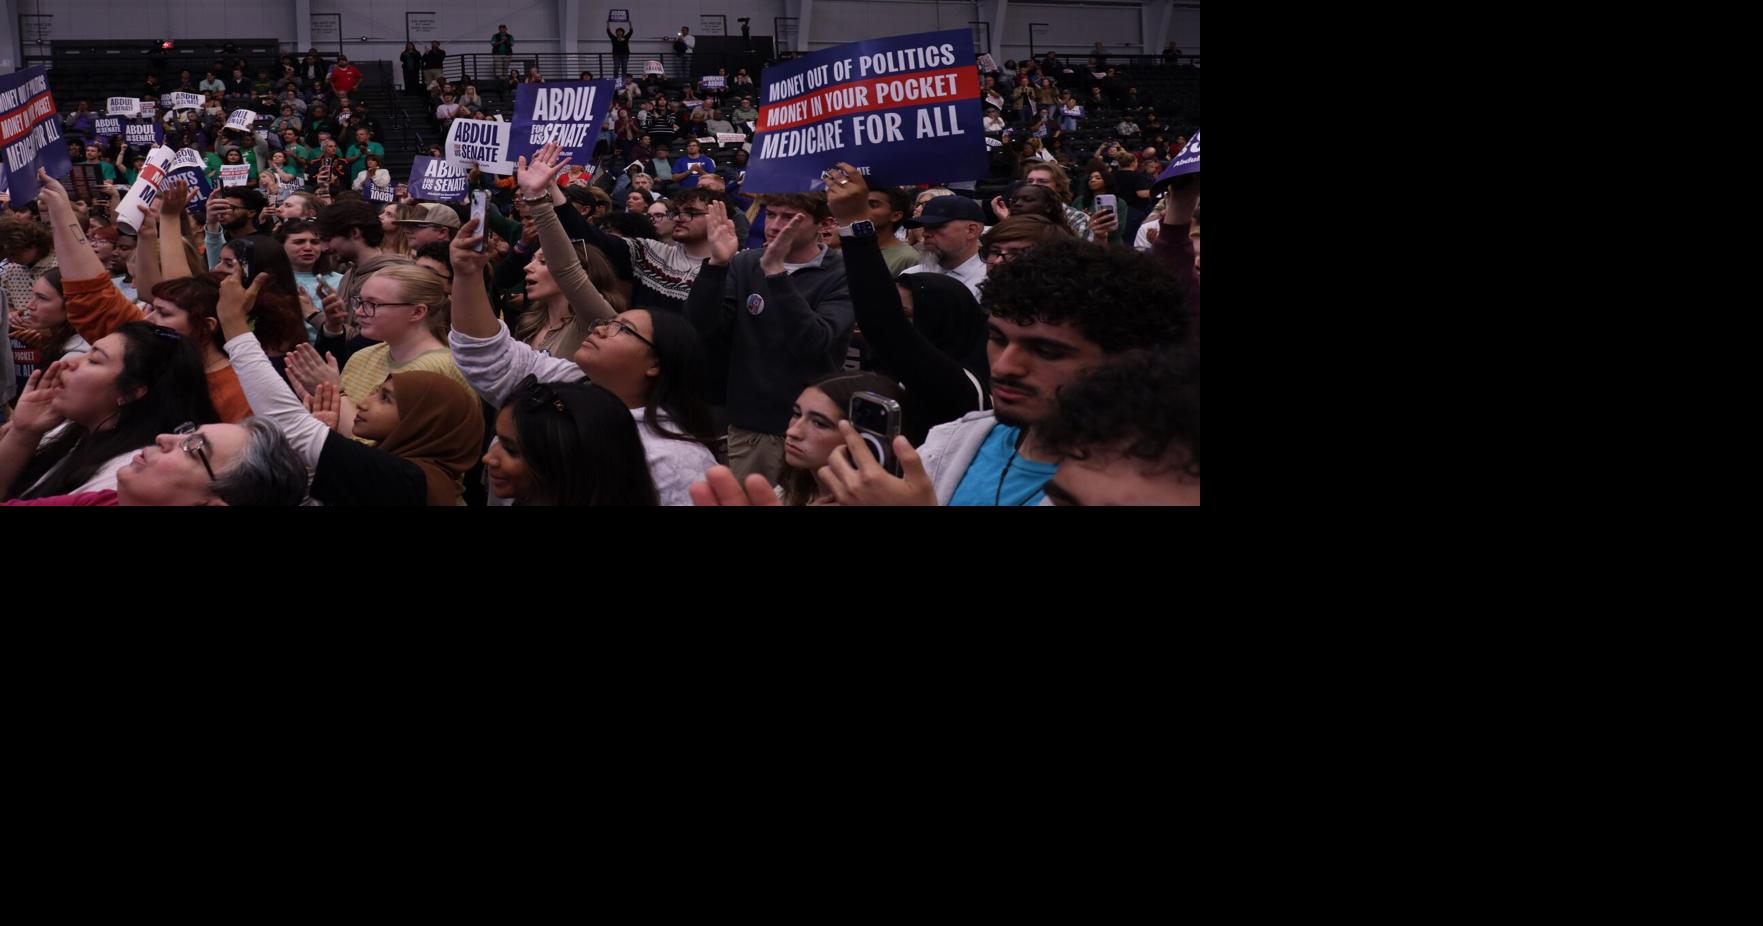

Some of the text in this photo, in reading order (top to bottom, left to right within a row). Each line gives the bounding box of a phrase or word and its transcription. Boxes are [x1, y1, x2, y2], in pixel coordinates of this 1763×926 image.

[769, 73, 805, 103] MONEY
[807, 64, 829, 90] OUT
[833, 58, 853, 82] OF
[859, 43, 956, 77] POLITICS
[110, 98, 133, 106] ABDUL
[532, 86, 597, 121] ABDUL
[766, 73, 958, 127] MONEY IN YOUR POCKET
[45, 118, 60, 144] ALL
[95, 118, 121, 128] ABDUL
[126, 124, 156, 135] ABDUL
[454, 121, 500, 146] ABDUL
[541, 123, 590, 148] SENATE
[759, 105, 965, 159] MEDICARE FOR ALL
[132, 134, 156, 142] SENATE
[461, 144, 499, 163] SENATE
[434, 177, 466, 192] SENATE
